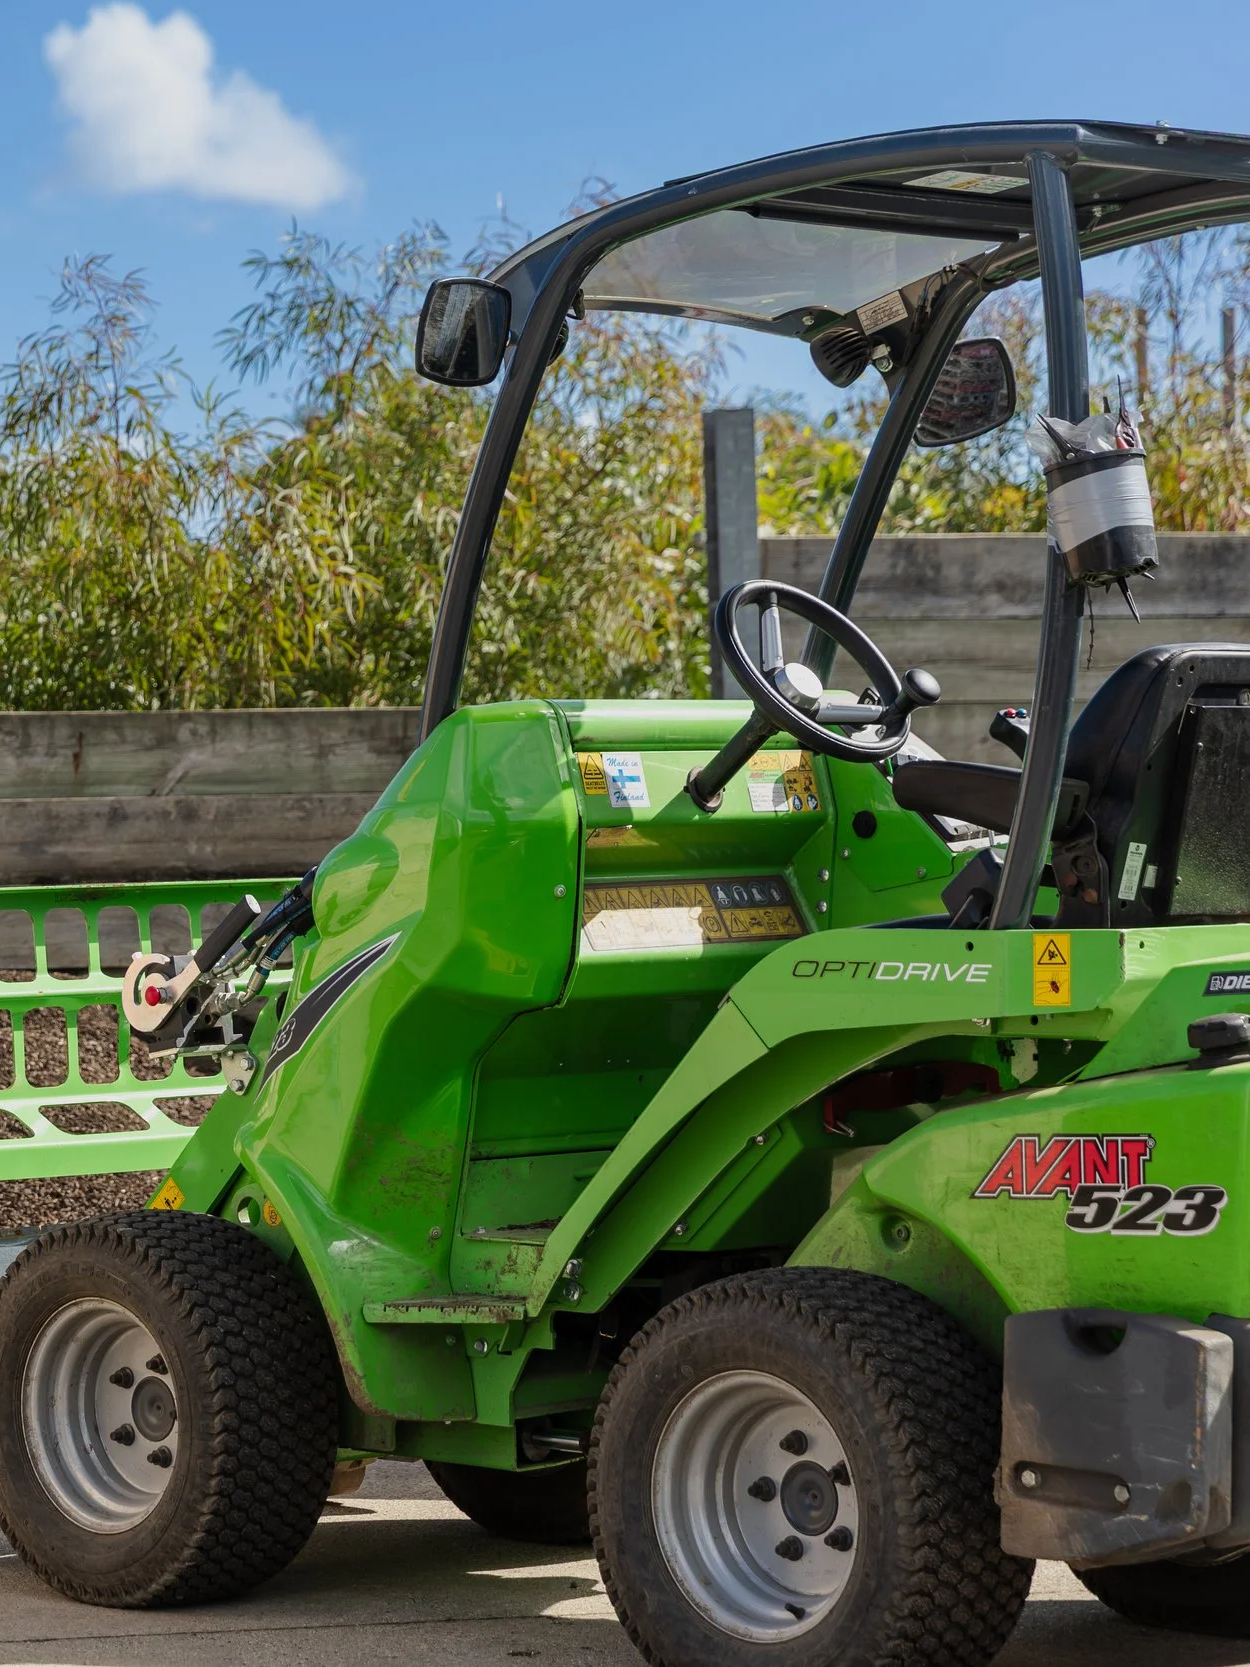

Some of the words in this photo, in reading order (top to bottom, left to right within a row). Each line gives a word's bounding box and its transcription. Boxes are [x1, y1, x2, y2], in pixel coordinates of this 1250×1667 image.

[607, 757, 628, 767] Made
[613, 791, 645, 803] Finland
[792, 960, 993, 982] OPTIDRIVE
[1065, 1183, 1228, 1236] 523
